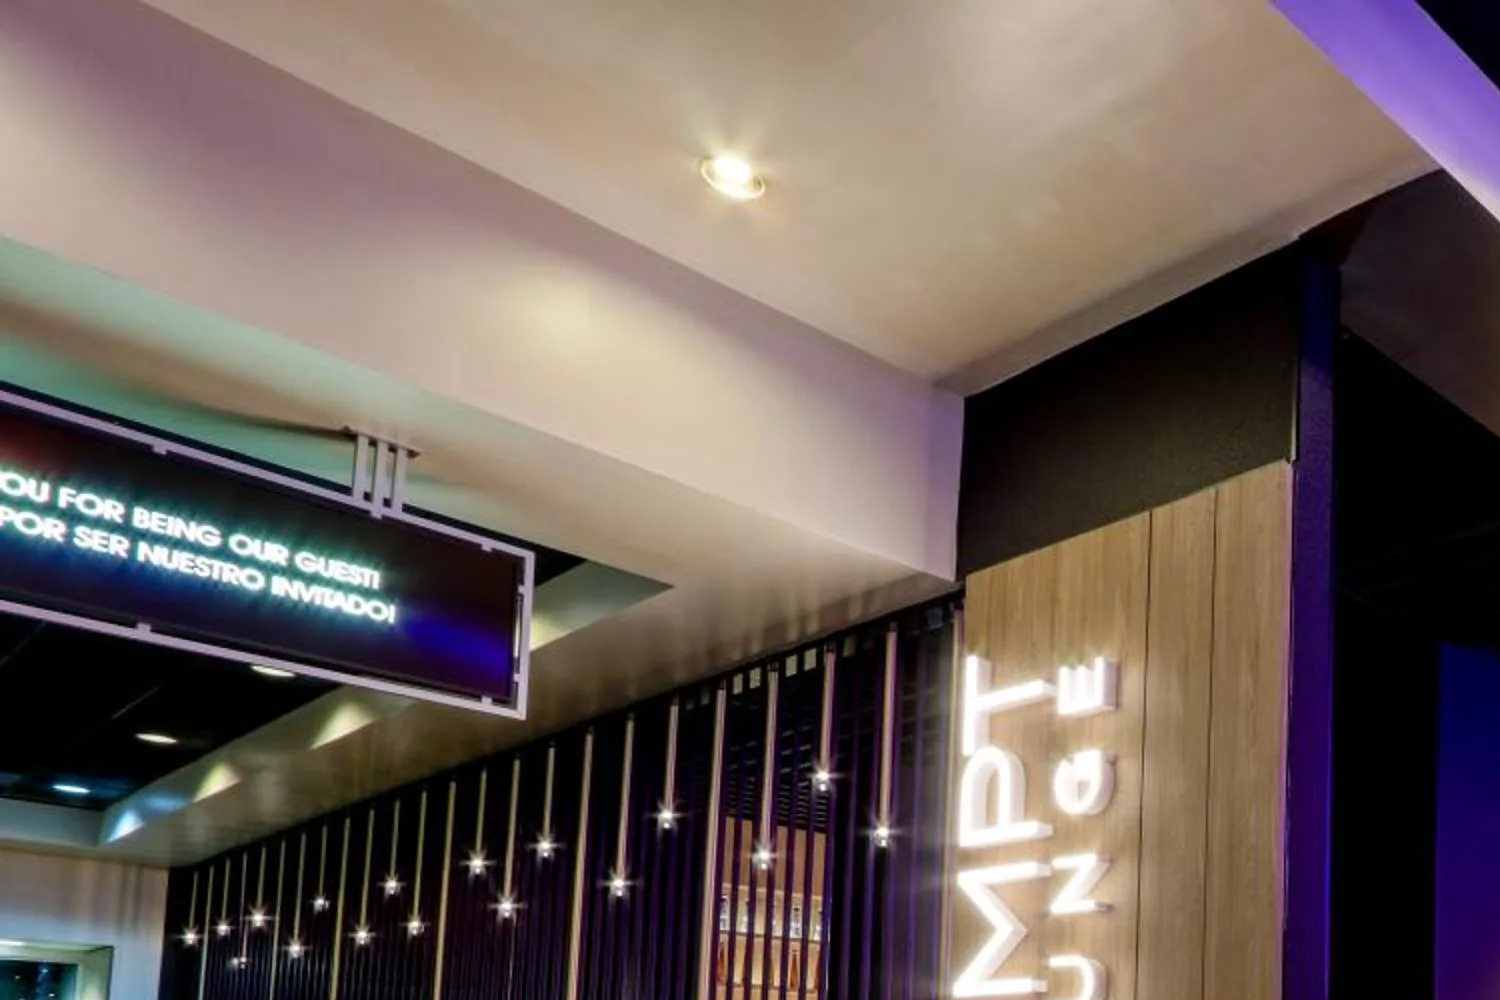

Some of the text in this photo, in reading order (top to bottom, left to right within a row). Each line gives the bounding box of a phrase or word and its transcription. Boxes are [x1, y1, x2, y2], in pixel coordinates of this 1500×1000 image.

[0, 471, 50, 503] OU
[58, 486, 125, 524] FOR
[133, 506, 222, 547] BEING
[229, 533, 289, 567] OUR
[0, 504, 396, 623] POR SER NUESTRO INVITADO!
